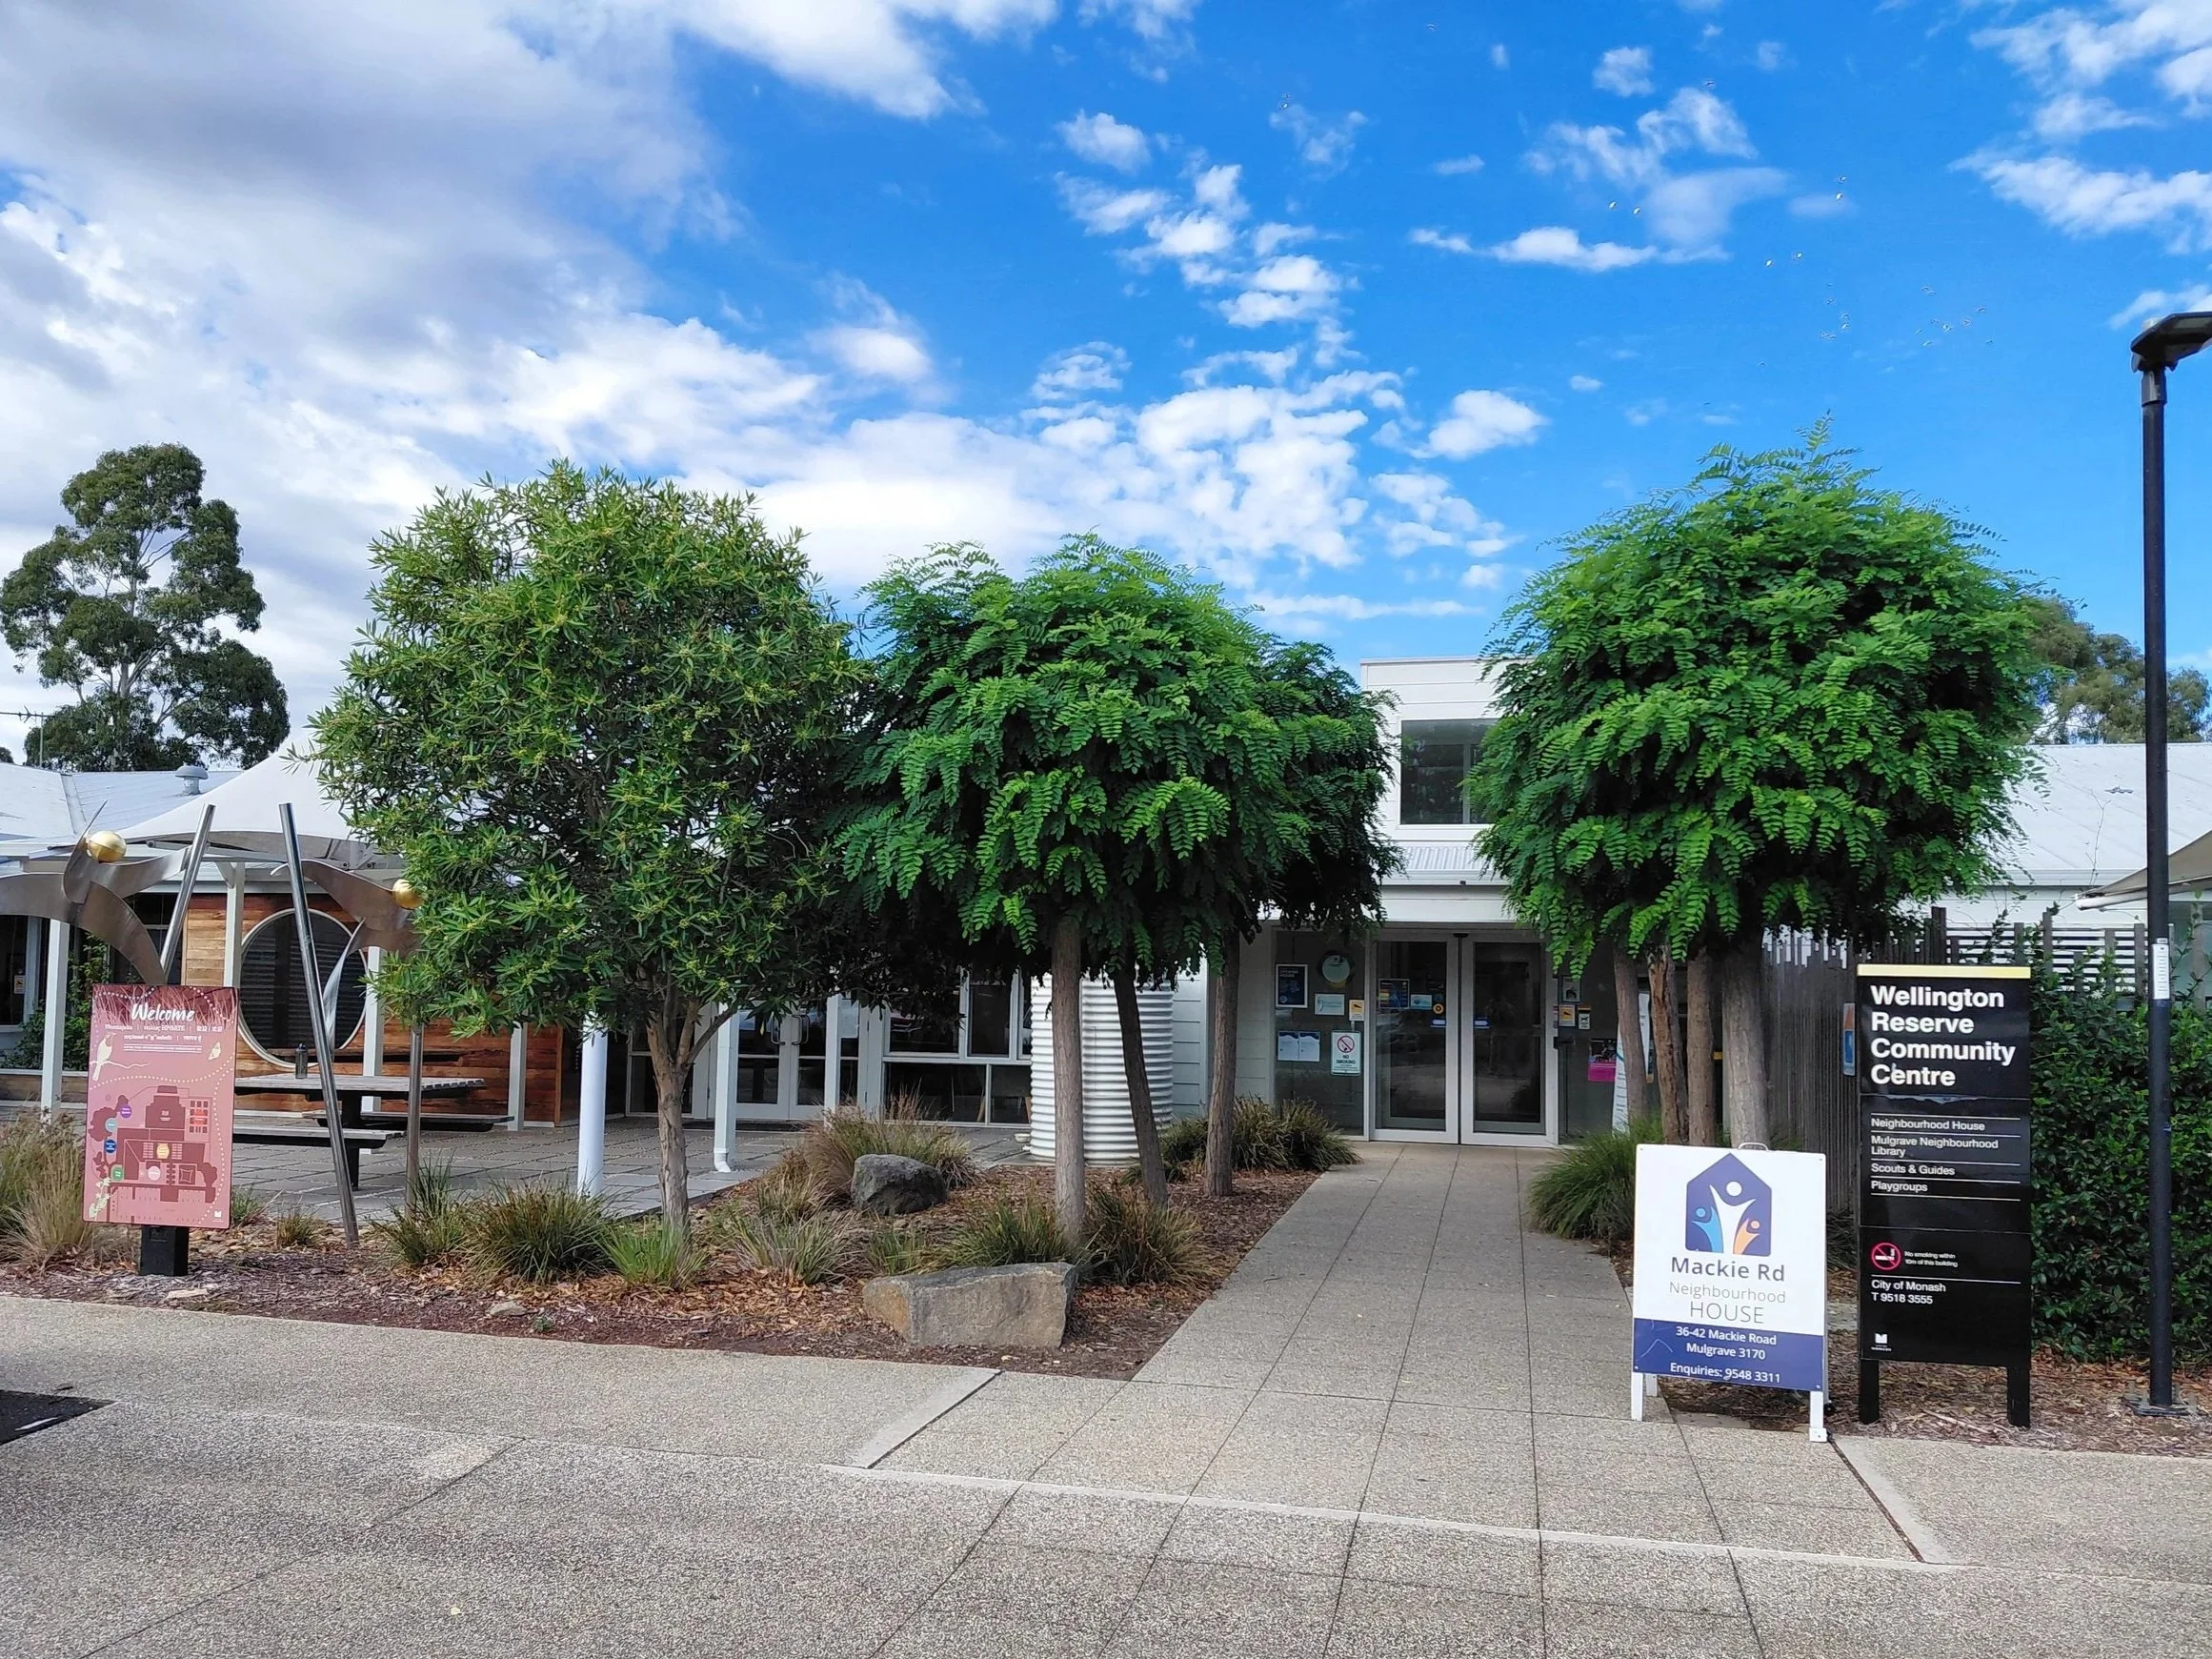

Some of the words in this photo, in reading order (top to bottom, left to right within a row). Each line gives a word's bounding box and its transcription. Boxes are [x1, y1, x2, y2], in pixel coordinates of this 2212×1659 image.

[1870, 984, 2004, 1012] Wellington
[131, 1002, 195, 1022] Welcome
[1871, 1012, 1975, 1034] Reserve
[1870, 1038, 2016, 1066] Community
[1870, 1064, 1956, 1086] Centre
[1871, 1118, 1950, 1131] Neighbourhood
[1952, 1121, 1985, 1131] House
[1871, 1135, 1918, 1147] Mulgrave
[1920, 1137, 1999, 1149] Neighbourhood
[1871, 1146, 1906, 1158] Library
[1871, 1163, 1906, 1174] Scouts
[1908, 1164, 1917, 1174] &
[1919, 1165, 1955, 1176] Guides
[1871, 1181, 1928, 1192] Playgroups
[1671, 1256, 1750, 1280] Mackie
[1758, 1264, 1785, 1282] Rd
[1669, 1281, 1786, 1304] Neighbourhood
[1871, 1280, 1891, 1291] City
[1893, 1281, 1904, 1289] of
[1905, 1282, 1946, 1292] Monash
[1871, 1292, 1879, 1301] T
[1880, 1293, 1906, 1303] 9518
[1907, 1294, 1934, 1304] 3555
[1690, 1301, 1765, 1324] HOUSE
[1676, 1325, 1706, 1339] 36-42
[1708, 1328, 1746, 1343] Mackie
[1748, 1332, 1777, 1345] Road
[1686, 1343, 1737, 1358] Mulgrave
[1739, 1346, 1766, 1361] 3170
[1670, 1362, 1723, 1379] Enquiries:
[1724, 1366, 1752, 1382] 9548
[1754, 1370, 1780, 1384] 3311
